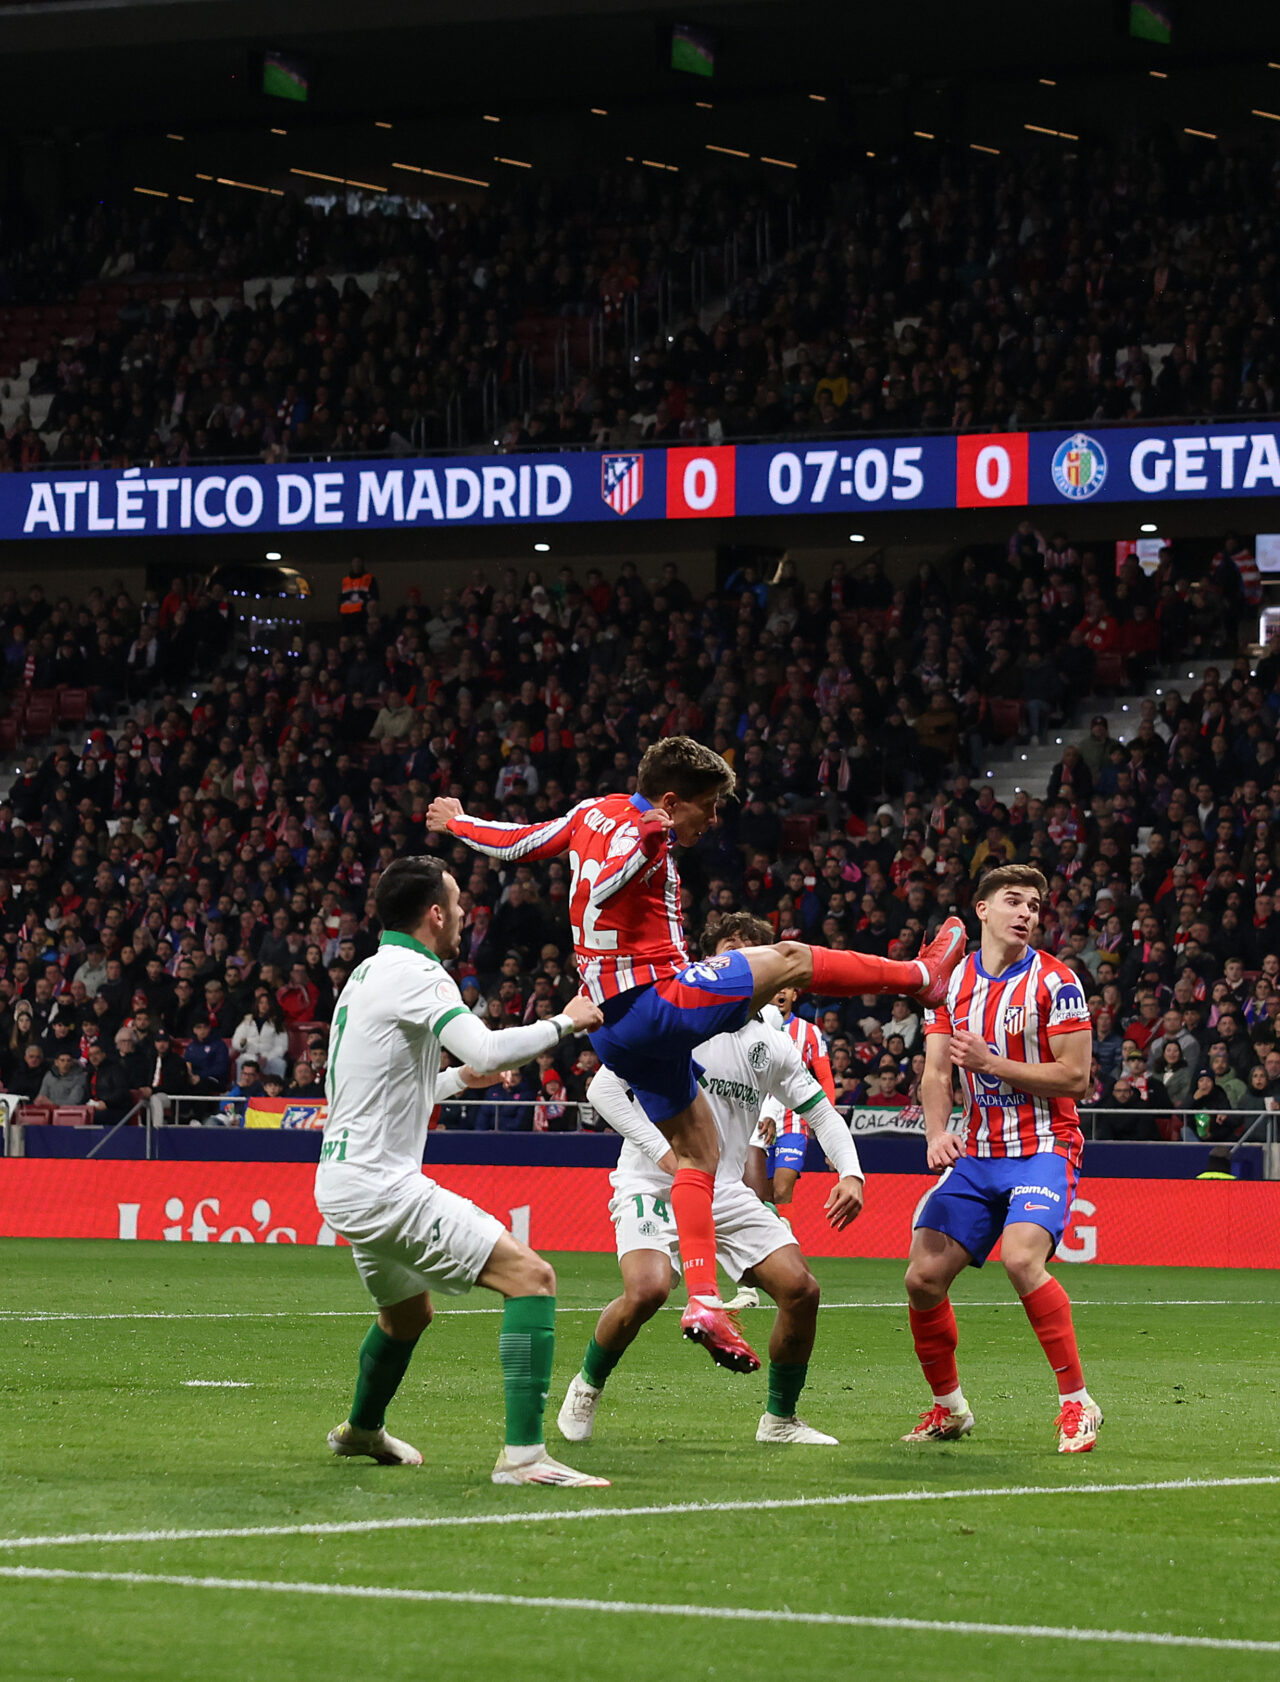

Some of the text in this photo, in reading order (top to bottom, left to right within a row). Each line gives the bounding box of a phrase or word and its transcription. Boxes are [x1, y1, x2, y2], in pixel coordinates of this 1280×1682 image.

[23, 464, 572, 533] ATLÉTICO DE MADRID
[683, 459, 717, 511] 0
[768, 447, 924, 504] 07:05
[975, 446, 1011, 499] 0
[709, 1078, 760, 1105] TECNOCAS
[1005, 1094, 1026, 1105] AIR
[632, 1194, 670, 1223] 14
